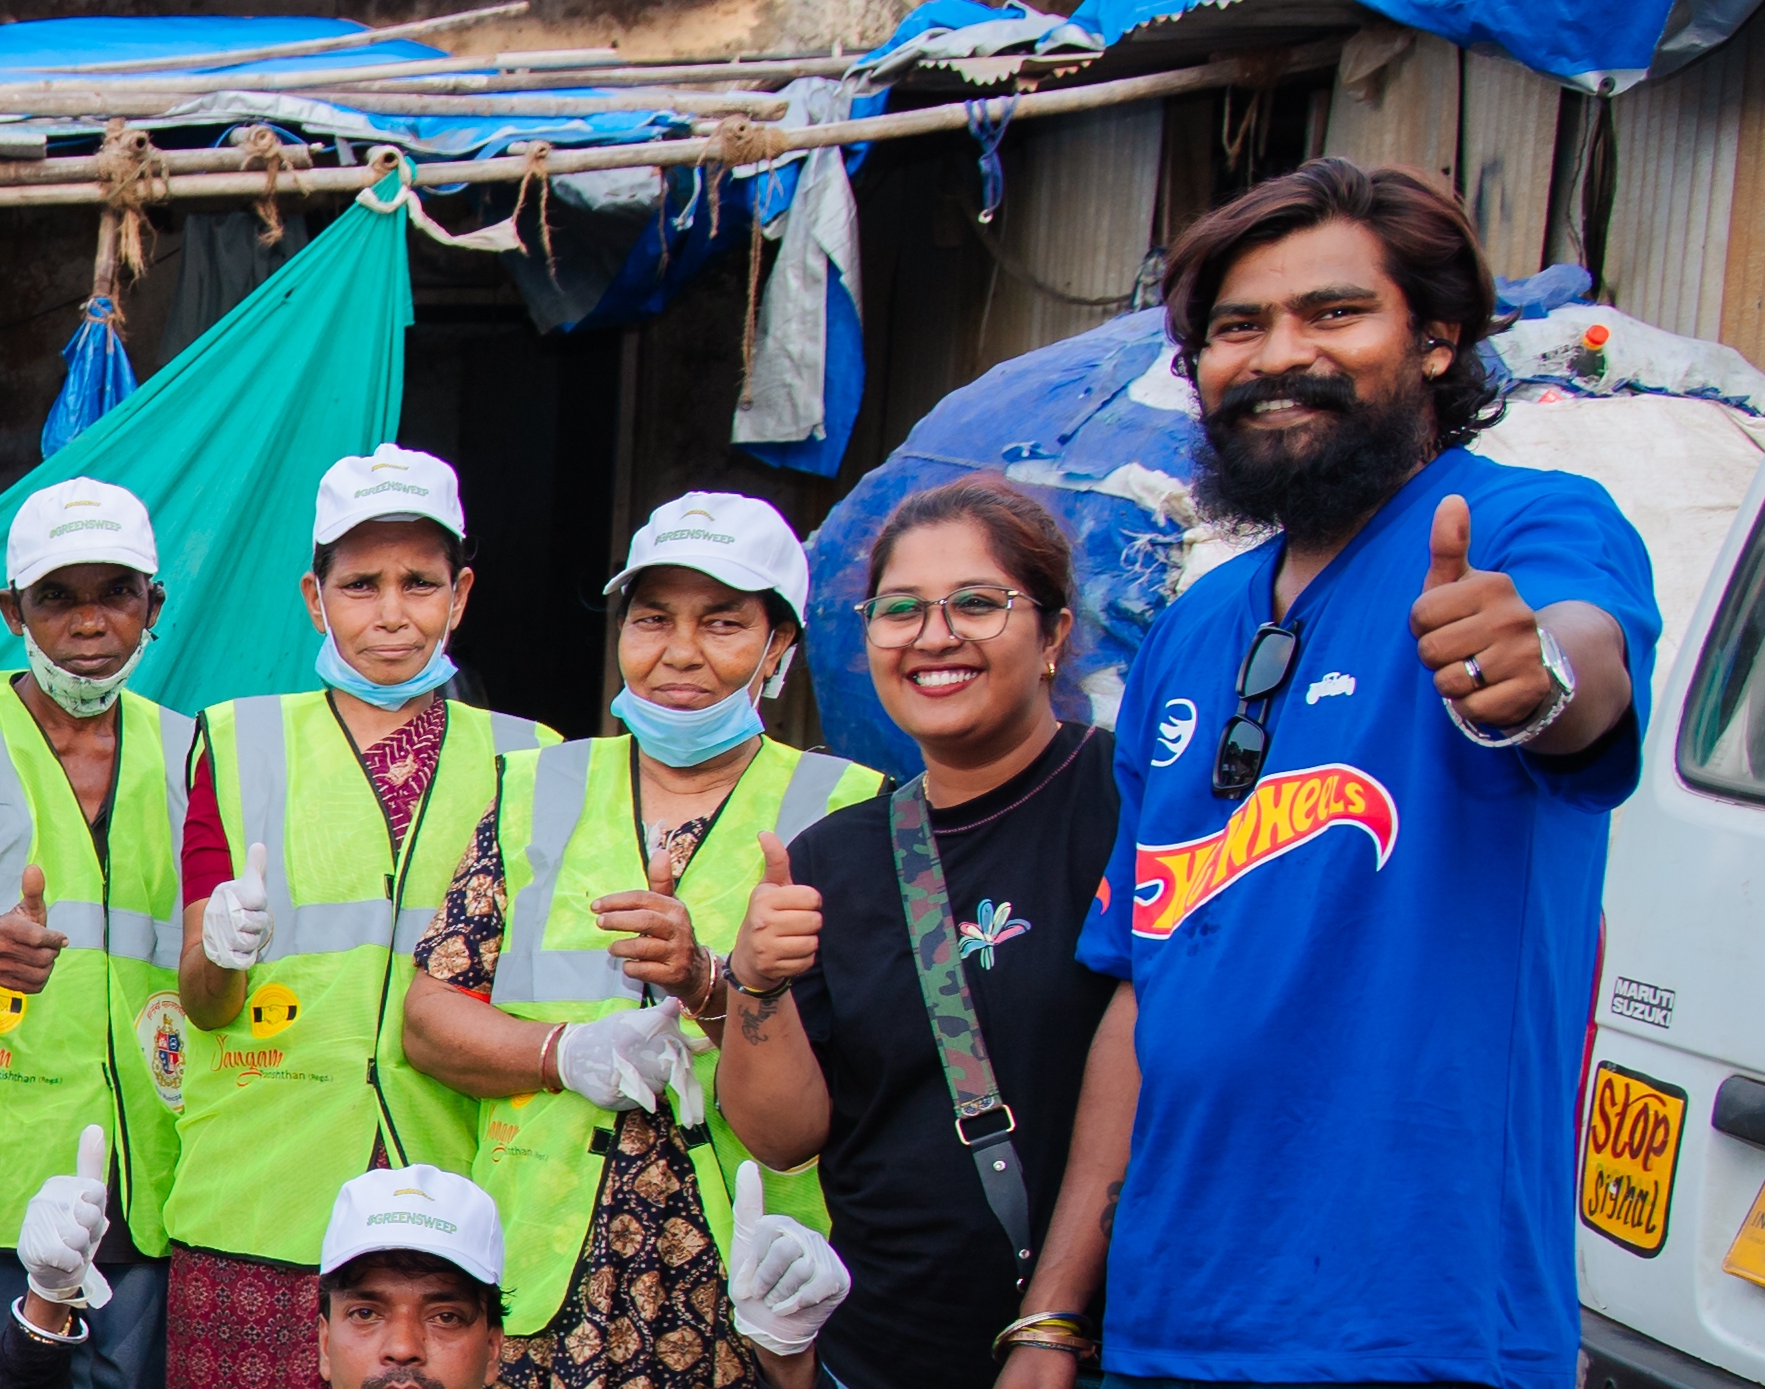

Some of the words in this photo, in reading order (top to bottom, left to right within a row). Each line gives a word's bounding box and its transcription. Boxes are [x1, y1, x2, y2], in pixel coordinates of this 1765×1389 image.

[355, 481, 429, 499] #GREENSWEEP
[49, 520, 122, 539] #GREENSWEEP
[652, 529, 735, 547] #GREENSWEEP
[1615, 978, 1675, 1009] MARUTI
[1612, 997, 1672, 1027] SUZUKI
[1592, 1077, 1670, 1171] Stop
[367, 1212, 457, 1234] #GREENSWEEP
